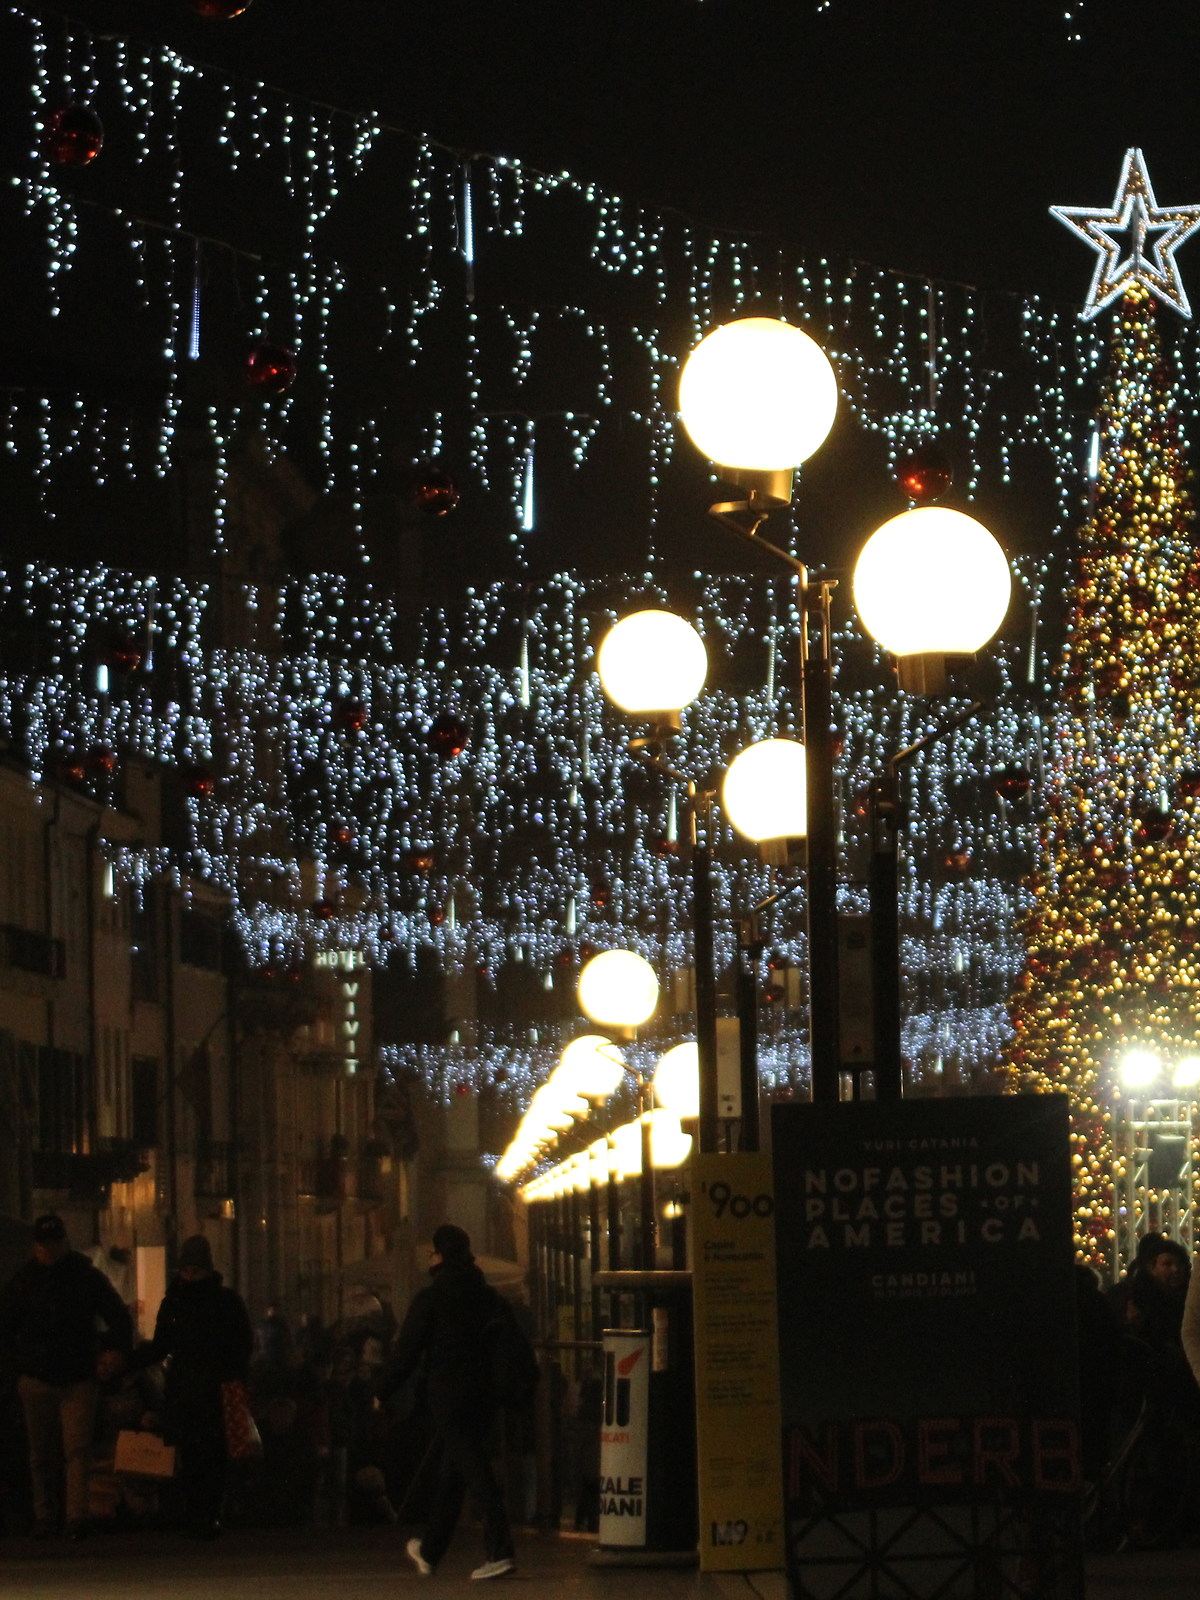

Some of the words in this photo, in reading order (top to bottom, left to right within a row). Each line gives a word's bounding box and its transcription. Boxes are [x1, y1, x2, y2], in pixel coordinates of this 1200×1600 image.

[316, 951, 366, 967] HOTEL
[343, 982, 360, 1074] VIVIT
[864, 1138, 901, 1150] YURI
[908, 1136, 979, 1150] CATANIA
[804, 1161, 1040, 1193] NOFASHION
[806, 1192, 959, 1221] PLACES
[995, 1196, 1027, 1210] OF
[807, 1217, 1041, 1249] AMERICA
[871, 1271, 976, 1288] CANDIANI
[787, 1416, 1082, 1500] NDERB
